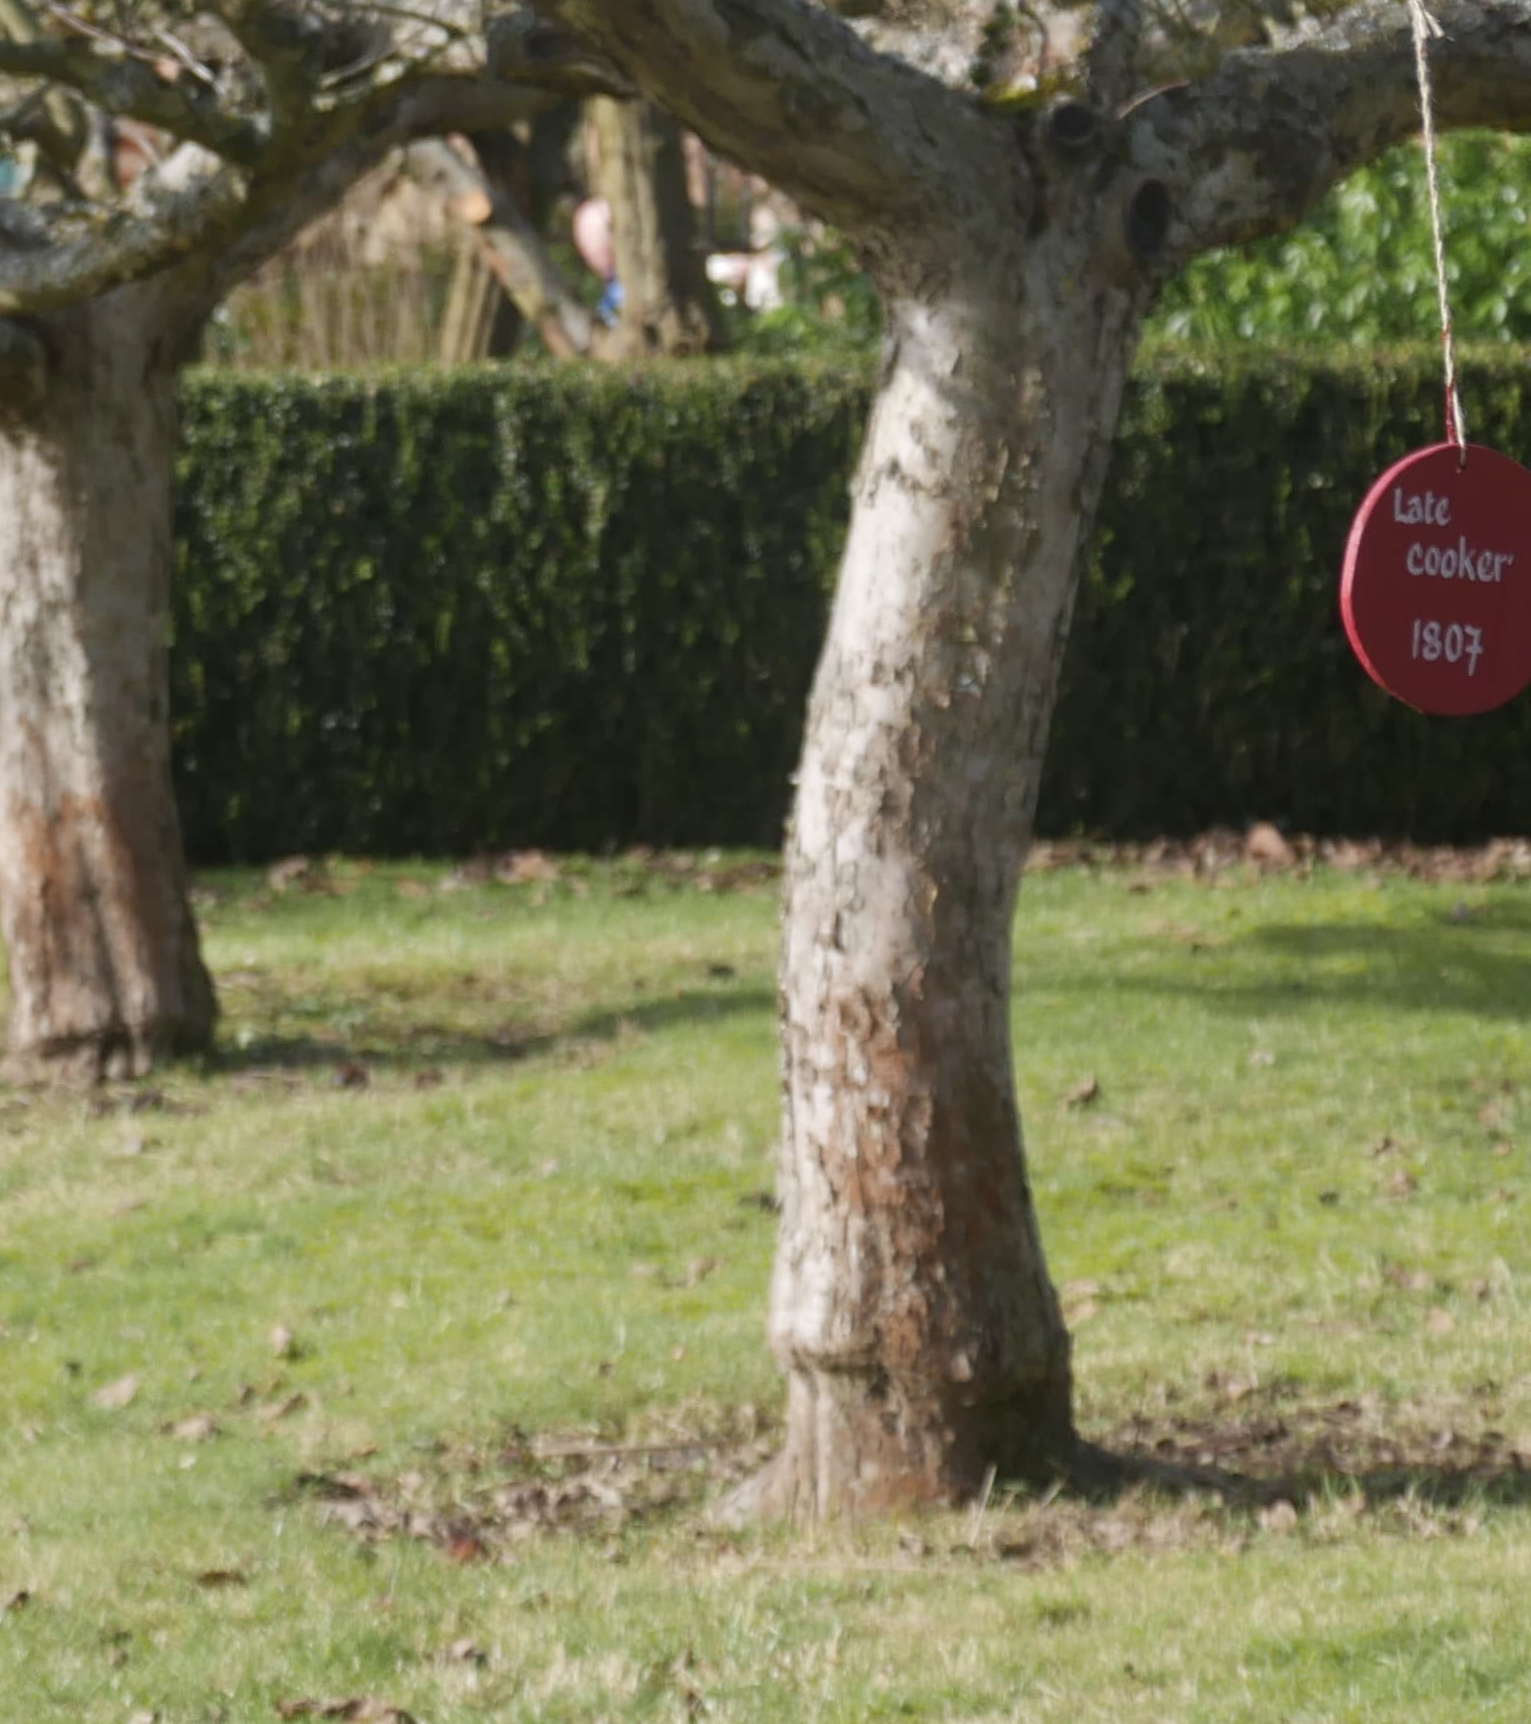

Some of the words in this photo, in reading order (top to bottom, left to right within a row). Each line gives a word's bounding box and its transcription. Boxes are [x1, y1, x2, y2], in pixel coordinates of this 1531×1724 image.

[1393, 486, 1451, 526] Late
[1406, 535, 1513, 581] cooker
[1412, 618, 1484, 676] 1807
